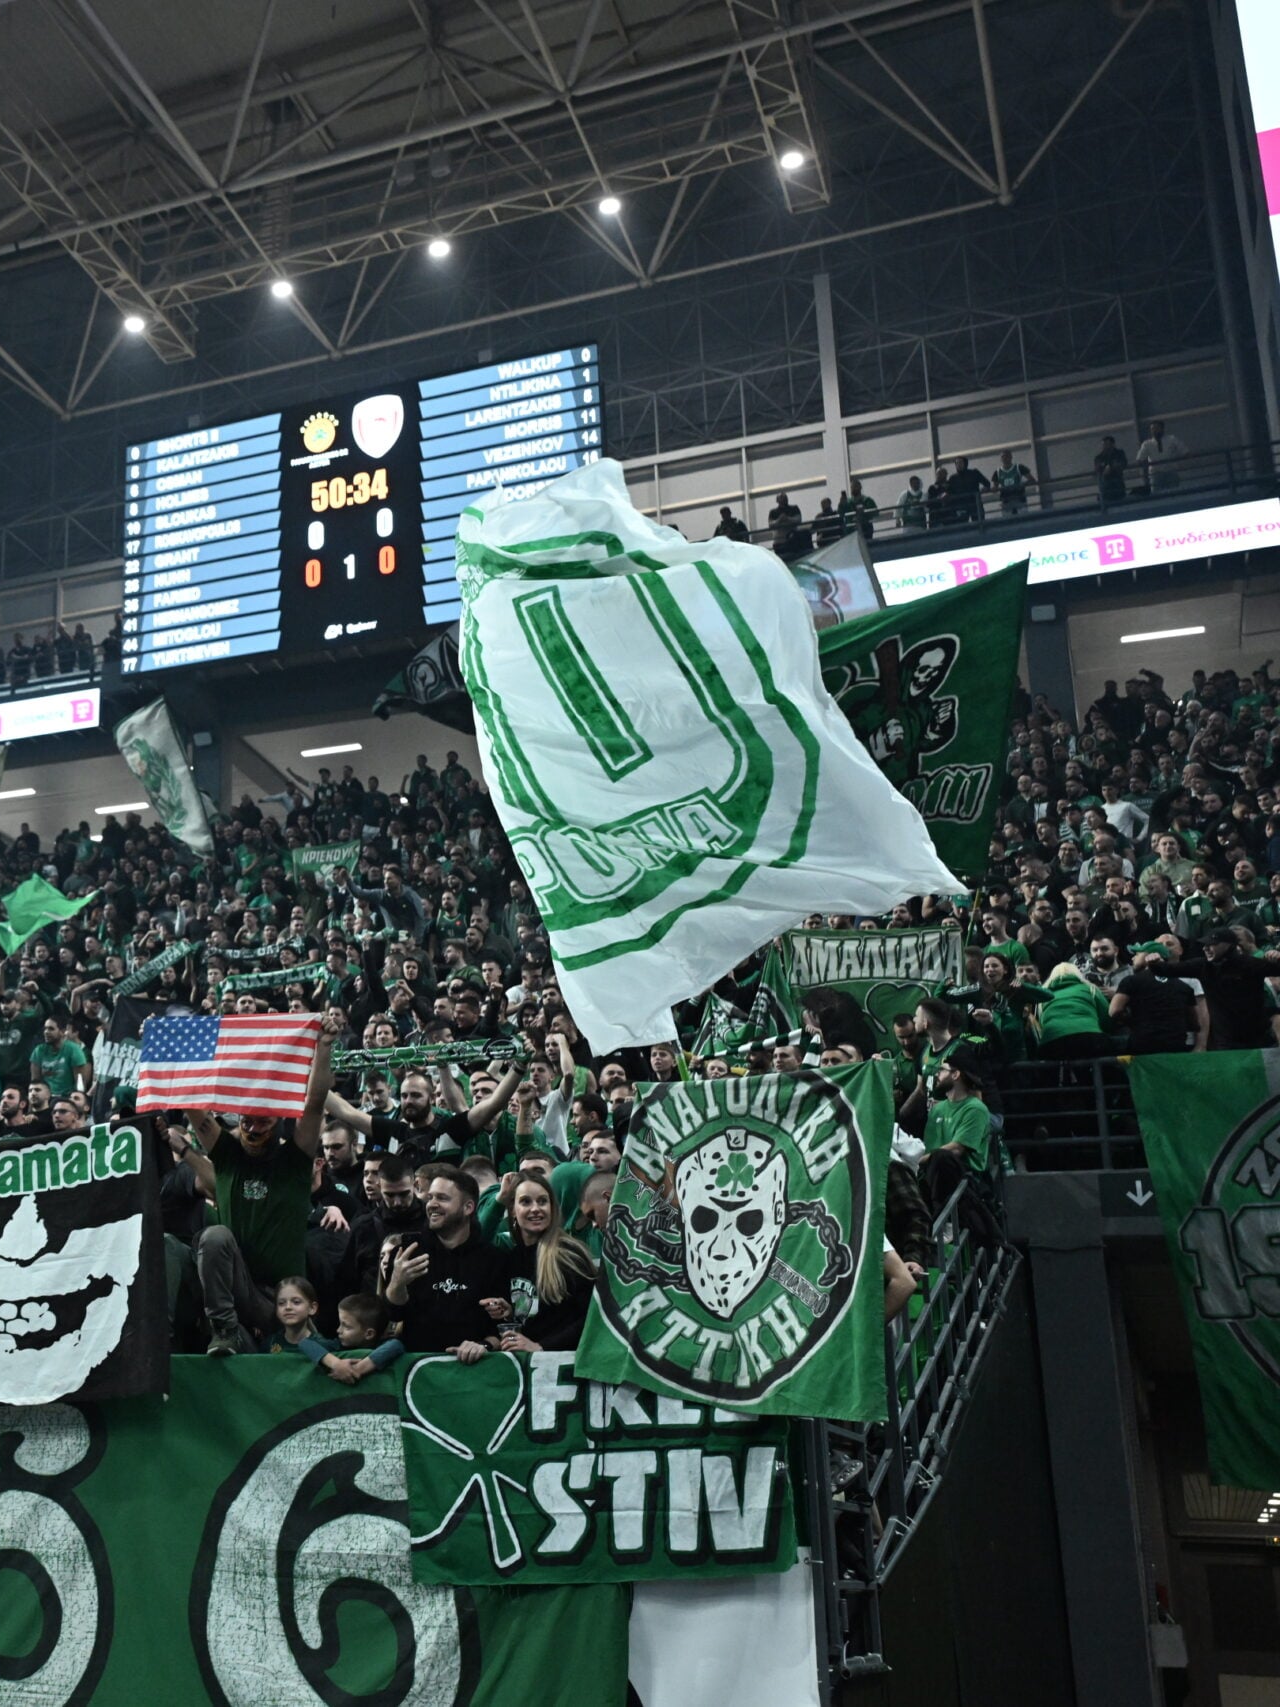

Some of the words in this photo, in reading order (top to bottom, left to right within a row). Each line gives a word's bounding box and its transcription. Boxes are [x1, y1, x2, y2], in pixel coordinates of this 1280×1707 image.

[498, 354, 561, 380] WALKUP
[581, 348, 591, 363] 0
[490, 374, 561, 401] NTILIKINA
[582, 368, 590, 382] 1
[465, 394, 562, 427] LARENTZAKIS
[504, 415, 562, 439] MORRIS
[581, 408, 597, 424] 11
[156, 443, 239, 473] KALAITZAKIS
[482, 436, 564, 464] VEZENKOV
[581, 430, 598, 445] 14
[311, 468, 389, 512] 50:34
[155, 506, 216, 530] SLOUKAS
[376, 508, 393, 537] 0
[126, 540, 140, 555] 17
[308, 521, 324, 550] 0
[1155, 526, 1252, 549] Συνδέουμε
[154, 548, 200, 568] GRANT
[343, 554, 355, 579] 1
[379, 545, 395, 574] 0
[305, 559, 321, 588] 0
[881, 572, 947, 592] OSMOTE
[123, 618, 137, 632] 41
[123, 638, 138, 652] 44
[152, 623, 221, 647] MITOGLOU
[122, 657, 137, 672] 77
[619, 1284, 808, 1388] ΑΤΤΙΚΗ
